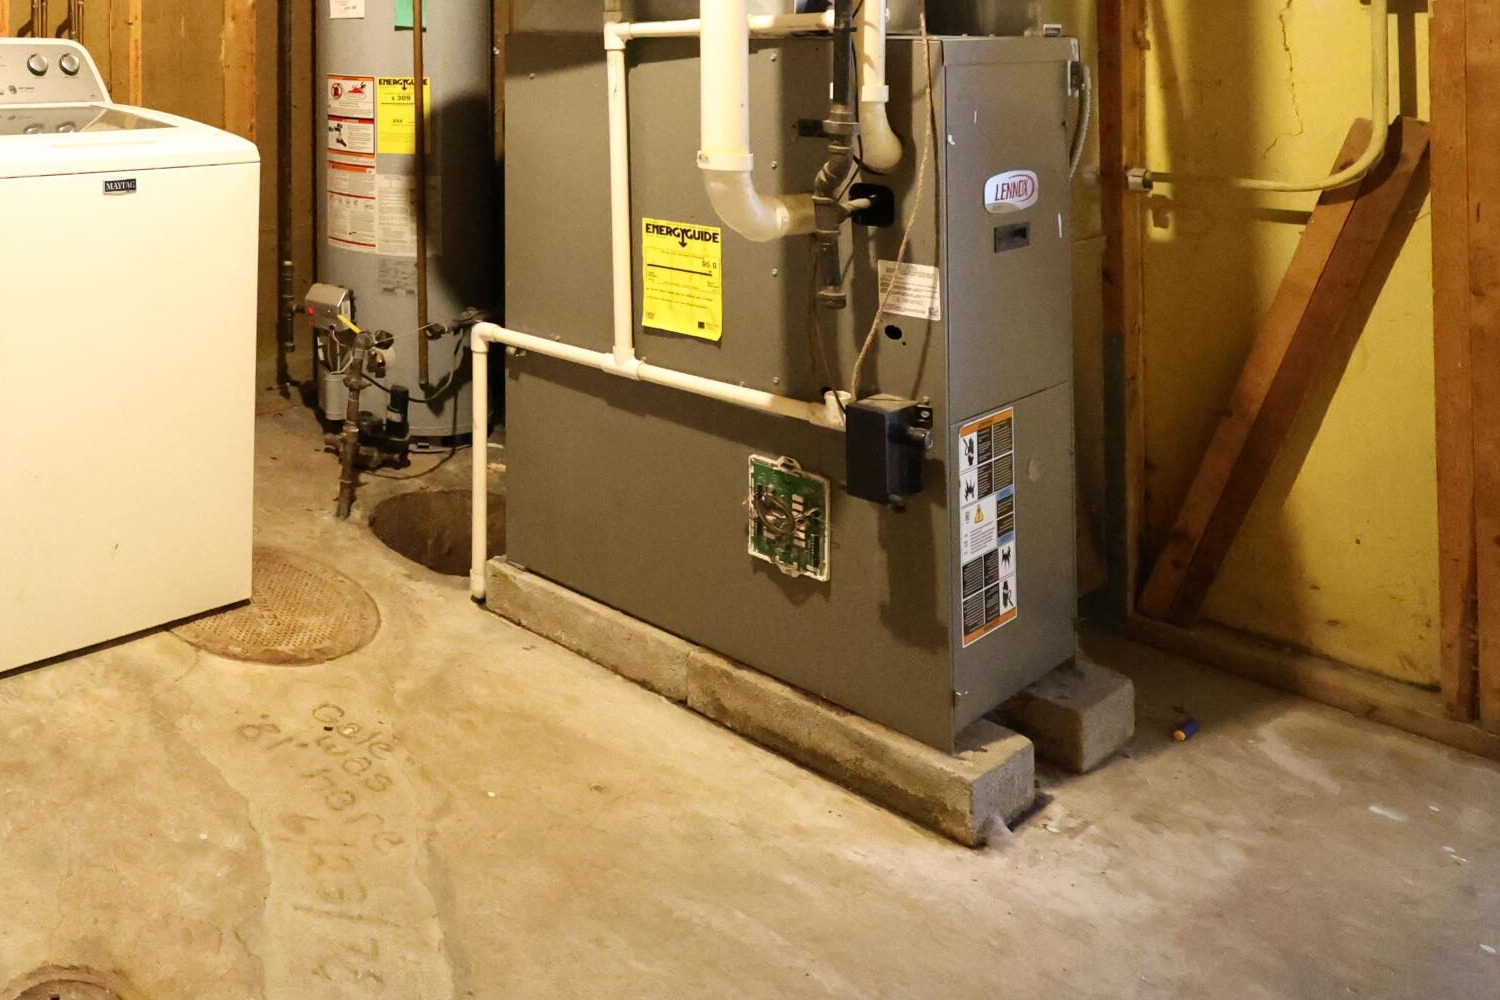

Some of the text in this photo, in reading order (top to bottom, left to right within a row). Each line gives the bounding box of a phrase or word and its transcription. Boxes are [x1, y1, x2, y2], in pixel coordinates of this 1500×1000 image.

[105, 180, 136, 191] MAYTAG
[994, 178, 1029, 202] LENNOX
[645, 223, 720, 244] ENERGYGUIDE
